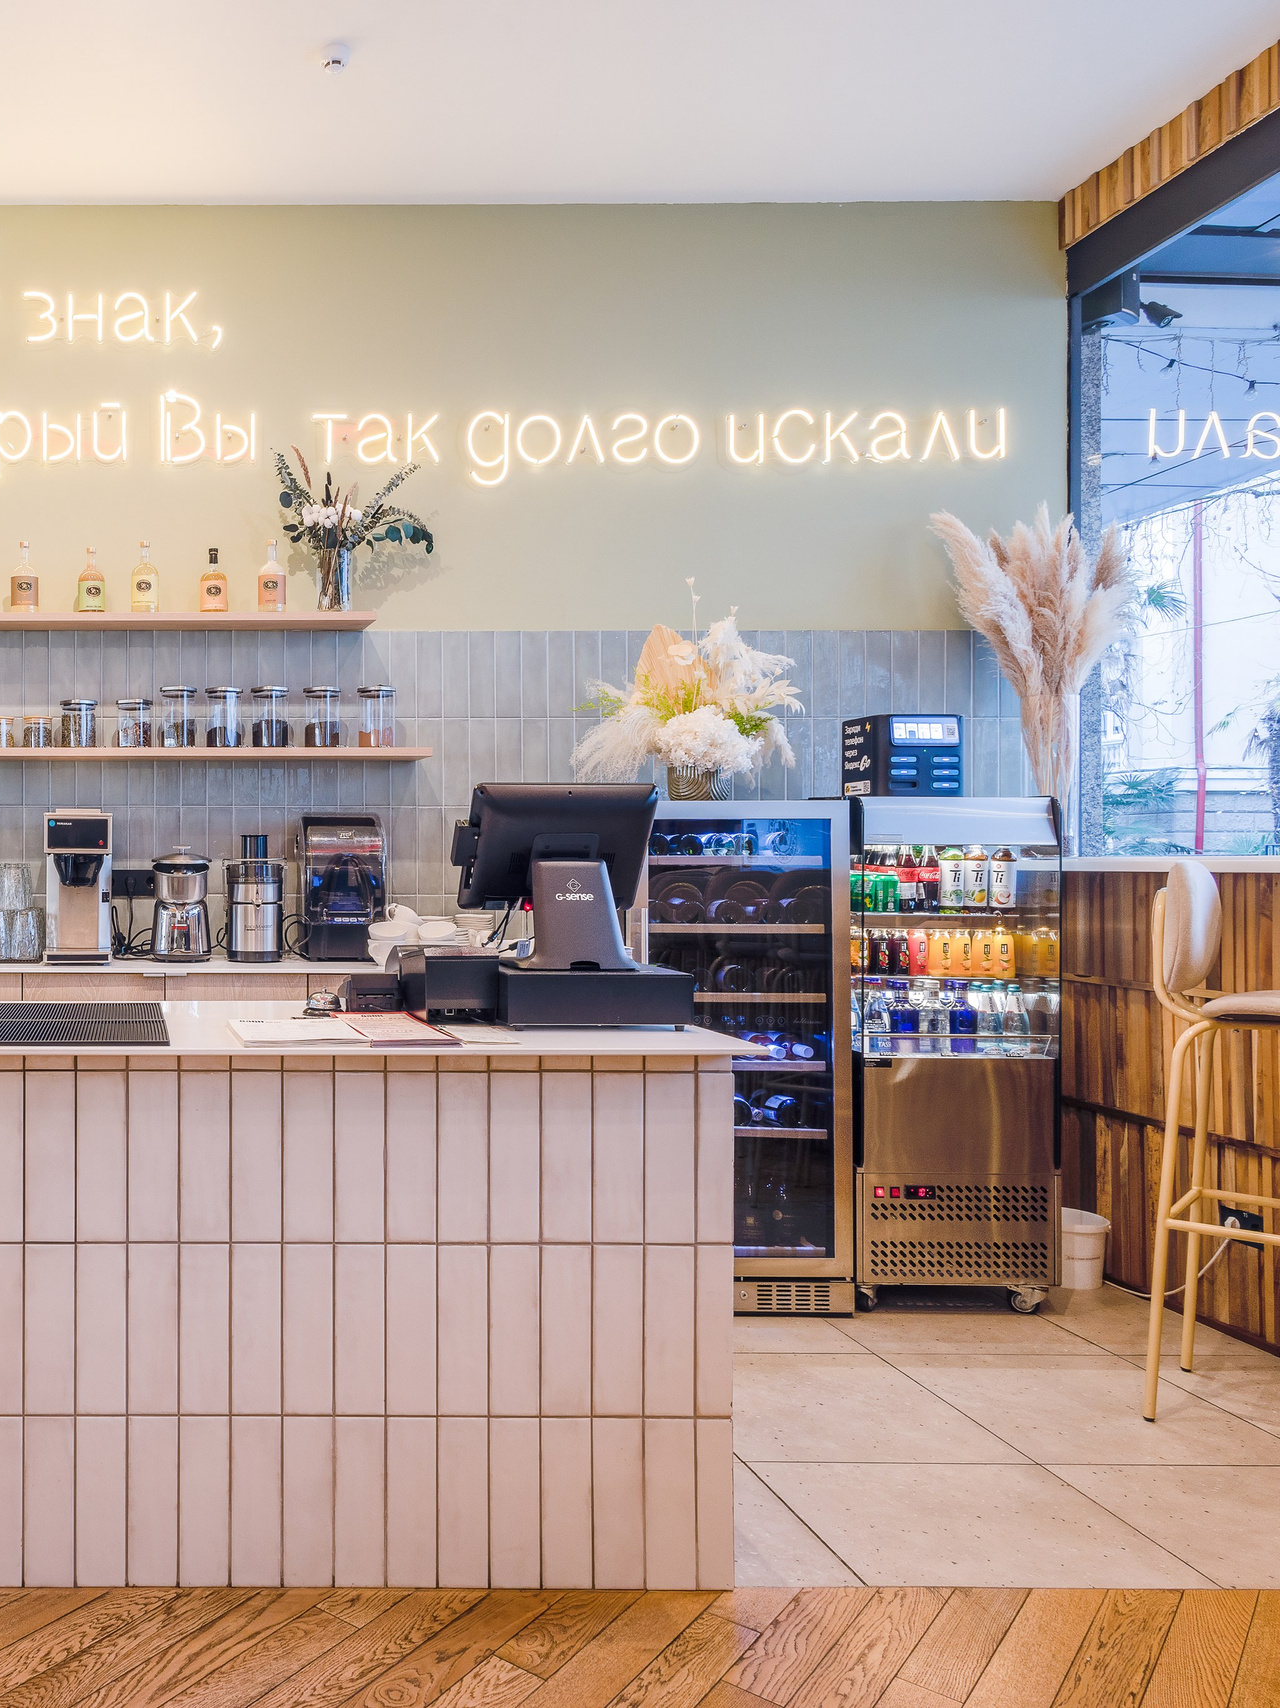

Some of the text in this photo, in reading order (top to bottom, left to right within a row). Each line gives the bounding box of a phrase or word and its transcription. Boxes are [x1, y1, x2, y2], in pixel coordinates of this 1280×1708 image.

[23, 290, 223, 349] знак,
[159, 390, 255, 464] Вы
[311, 412, 439, 464] так
[467, 411, 700, 486] долго
[726, 408, 1006, 465] искали
[555, 893, 594, 901] G-sense
